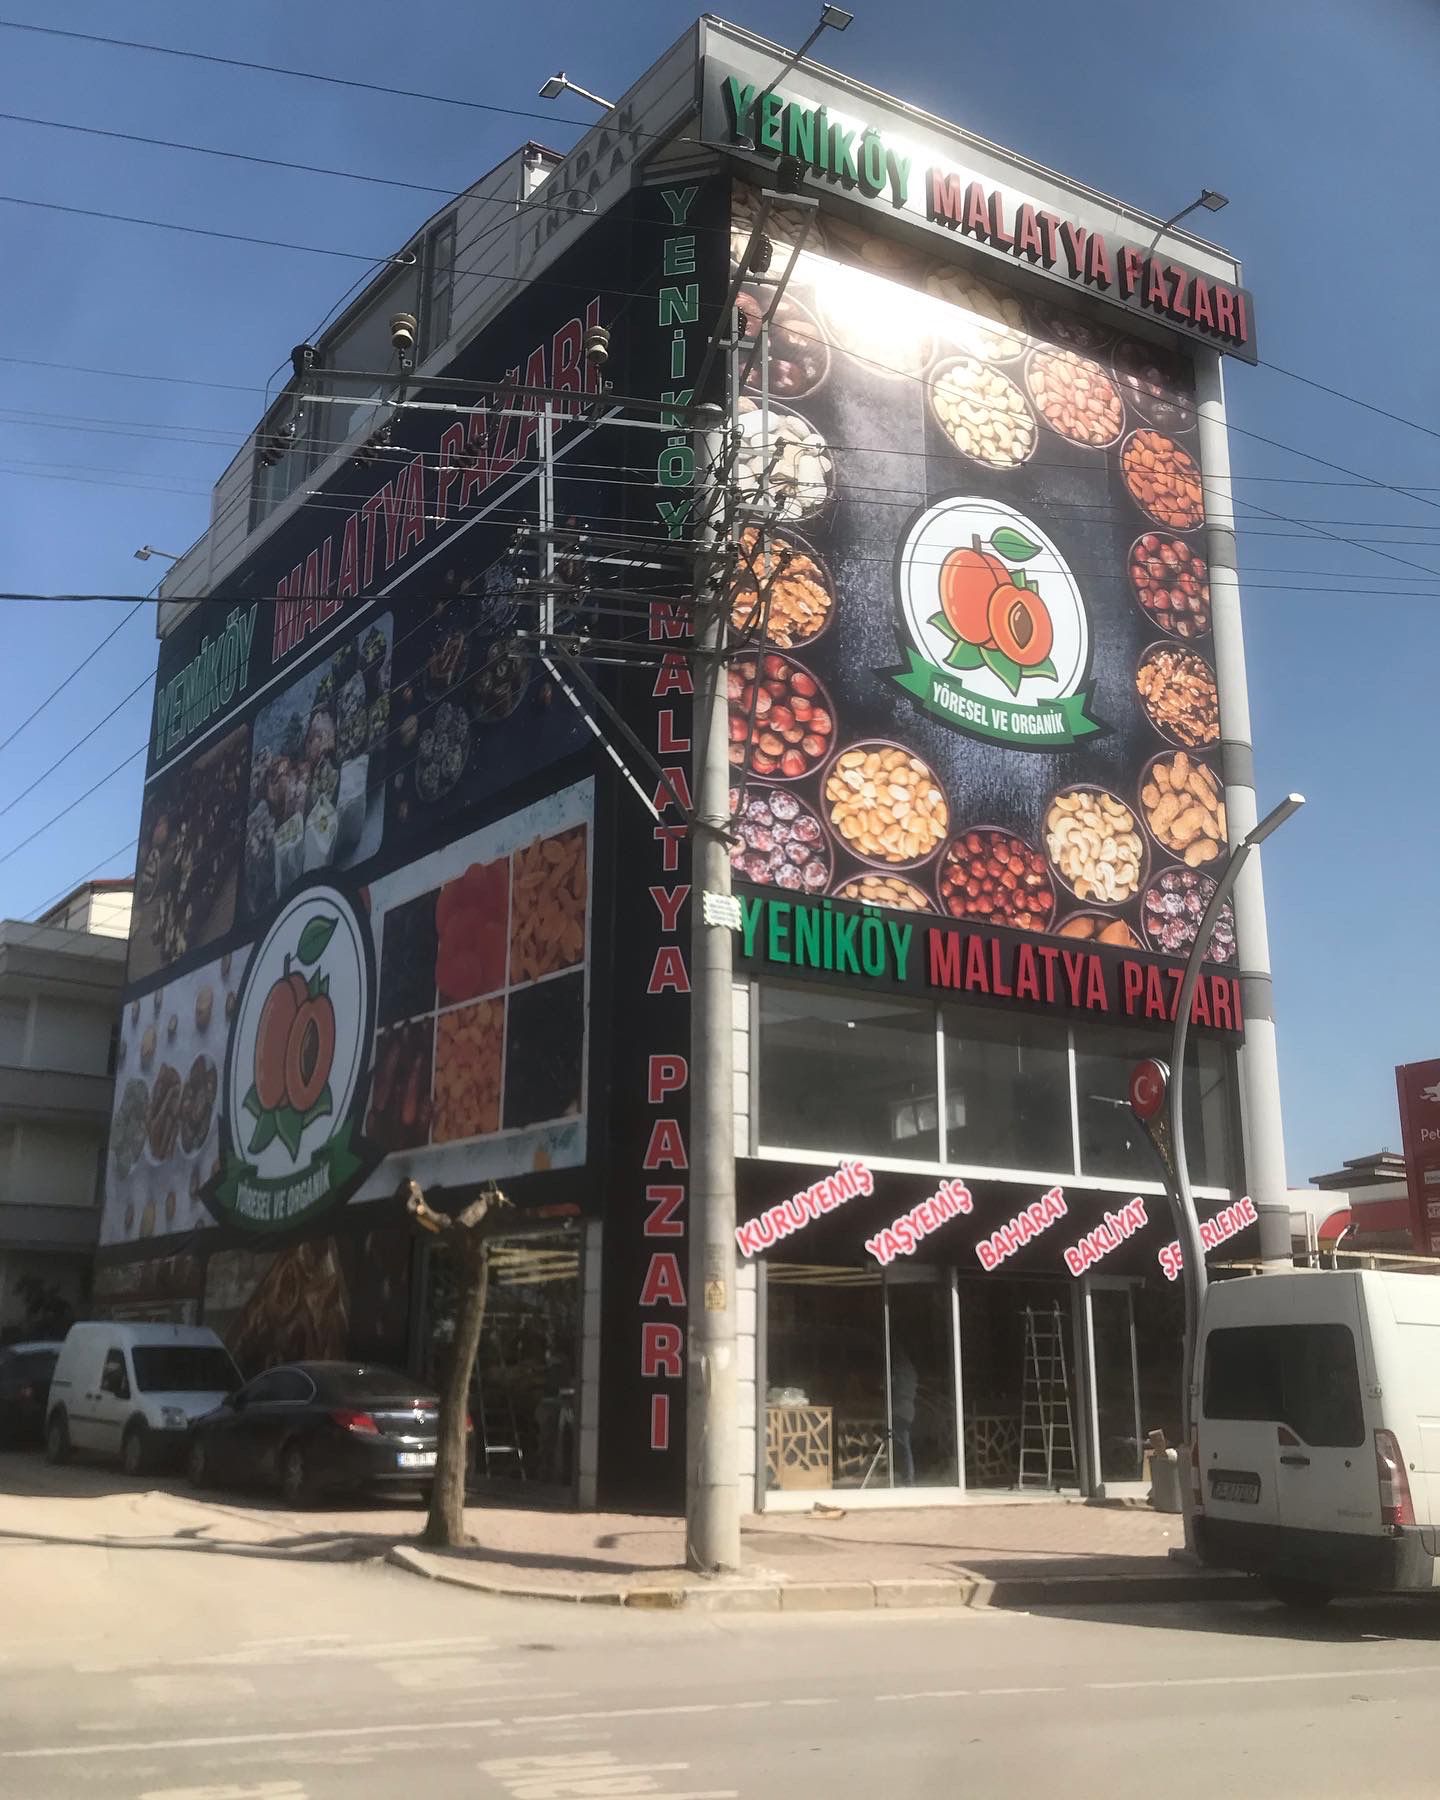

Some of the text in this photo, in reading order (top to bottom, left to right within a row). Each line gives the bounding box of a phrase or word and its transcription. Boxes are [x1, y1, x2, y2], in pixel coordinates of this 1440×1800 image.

[724, 76, 1249, 342] YENİKÖY MALATYA PAZARI
[156, 296, 601, 759] YENİKÖY MALATYA PAZARI
[932, 681, 1065, 735] YÖRESEL VE ORGANİK
[639, 186, 699, 1449] YENİKÖY MALATYA PAZARI
[737, 894, 1244, 1032] YENİKÖY MALATYA PAZARI
[736, 1160, 874, 1258] KURUYEMİŞ
[865, 1180, 973, 1266] YAŞYEMİŞ
[975, 1187, 1070, 1272] BAHARAT
[1065, 1197, 1149, 1277] BAKLİYAT
[1158, 1196, 1258, 1281] ŞERLEME
